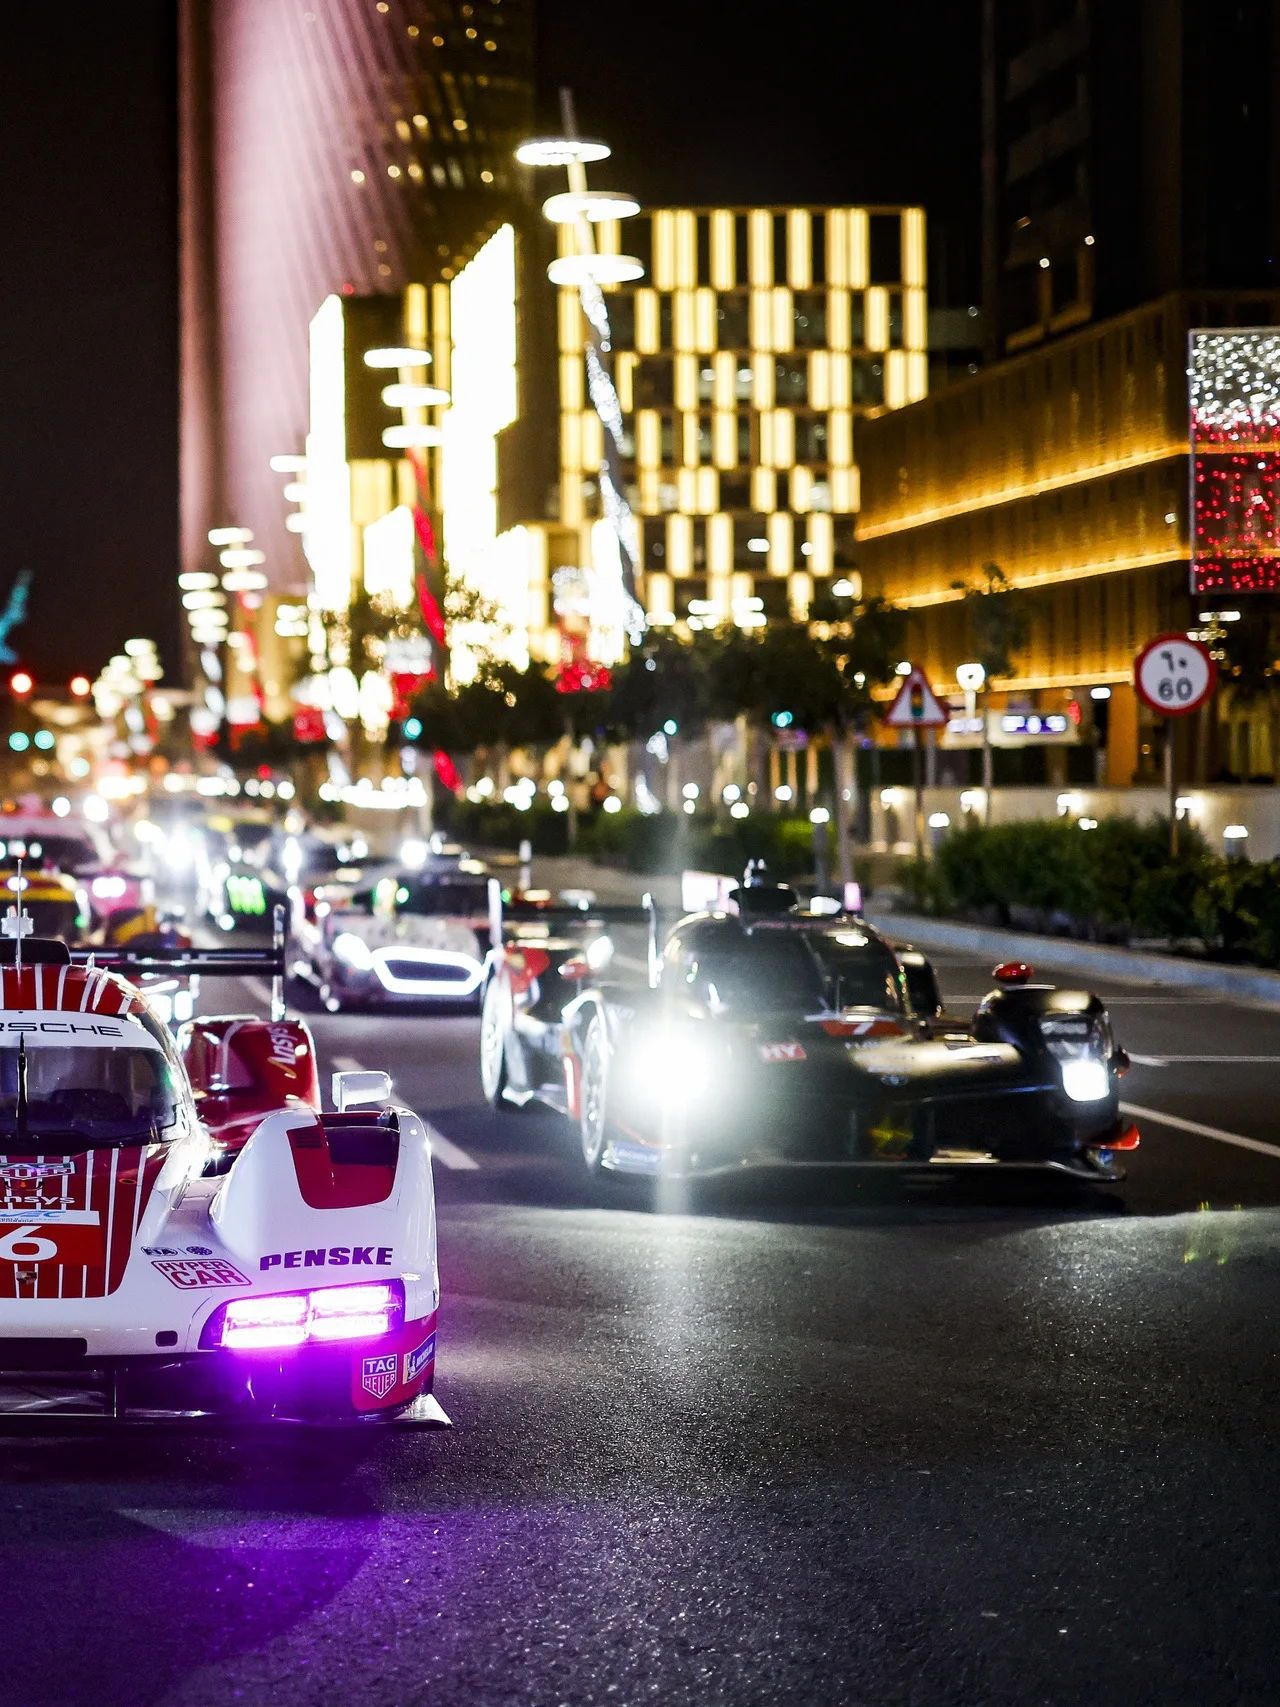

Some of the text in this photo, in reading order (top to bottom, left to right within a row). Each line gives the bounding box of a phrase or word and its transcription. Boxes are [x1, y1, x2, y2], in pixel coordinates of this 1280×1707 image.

[1159, 677, 1192, 701] 60
[157, 1261, 229, 1272] HYPER
[259, 1247, 393, 1271] PENSKE
[168, 1269, 244, 1287] CAR
[366, 1358, 395, 1373] TAG
[365, 1373, 395, 1395] HEUER
